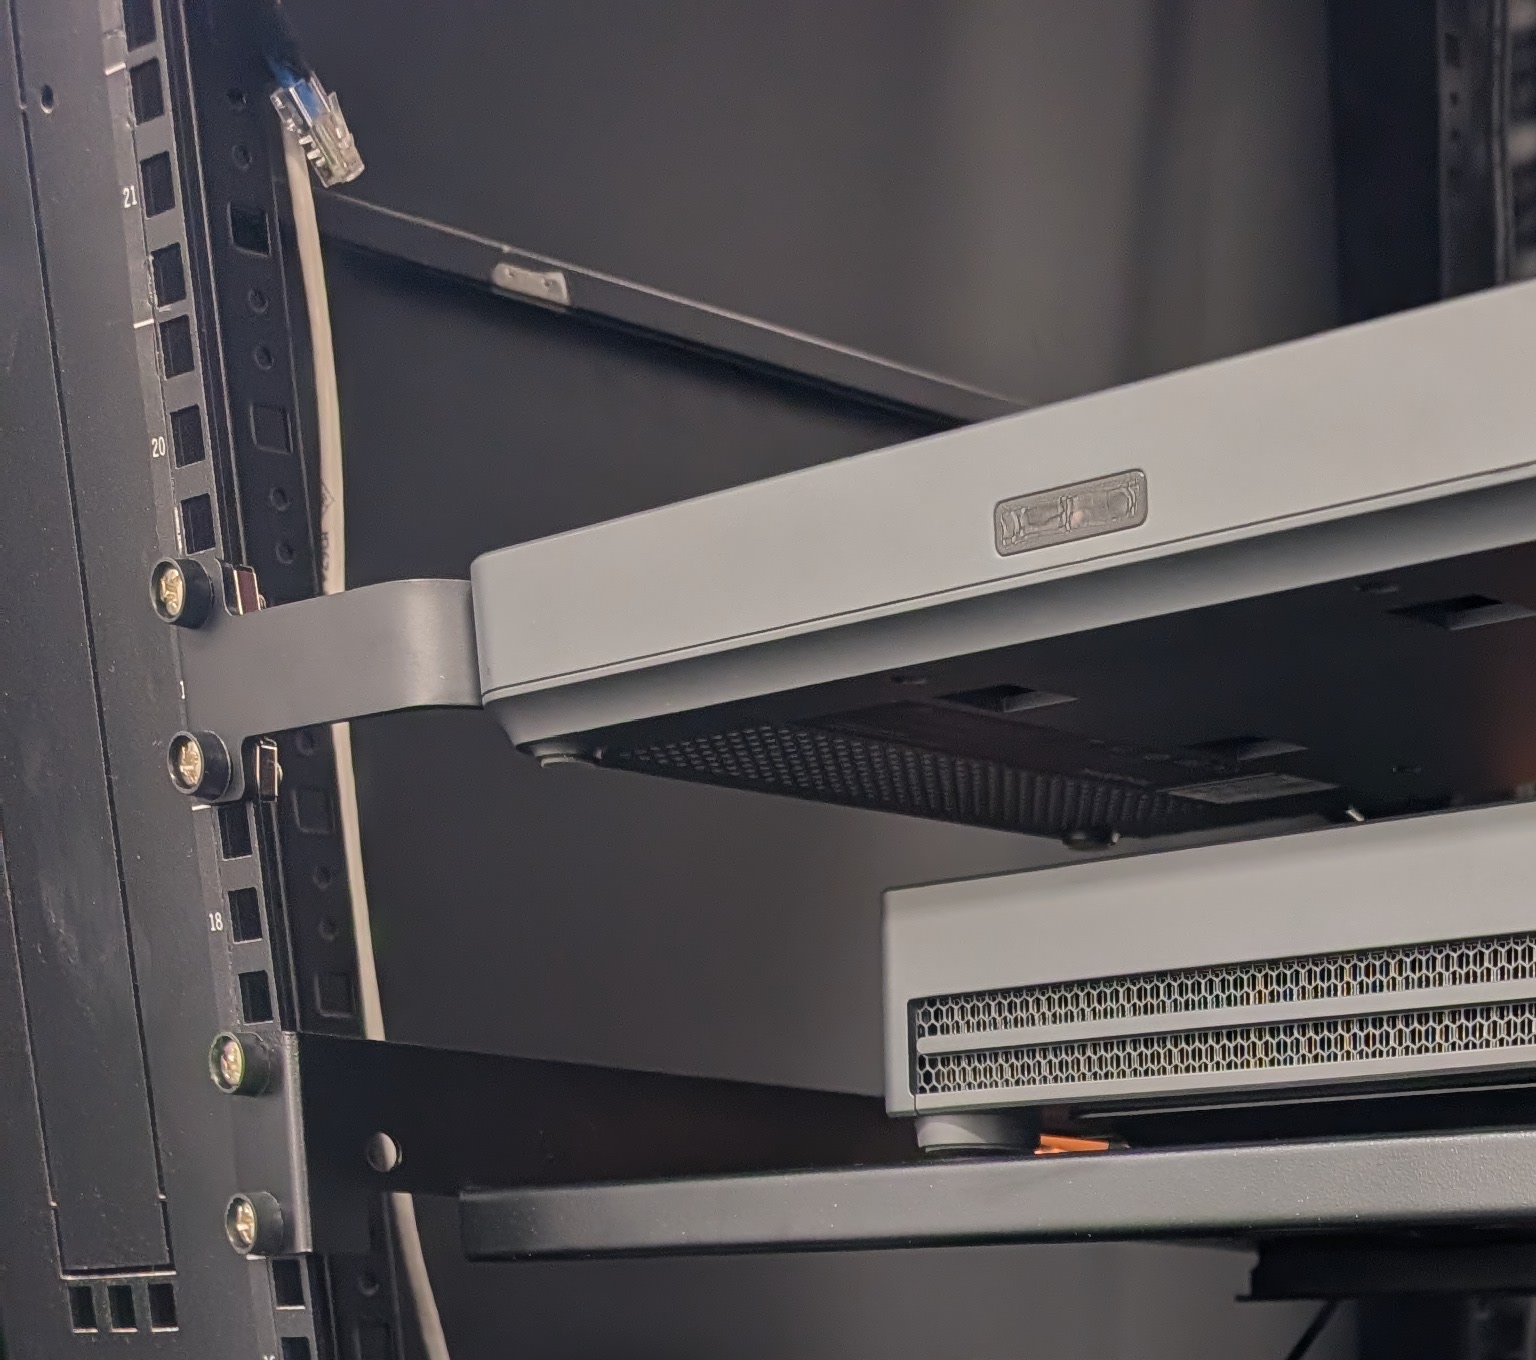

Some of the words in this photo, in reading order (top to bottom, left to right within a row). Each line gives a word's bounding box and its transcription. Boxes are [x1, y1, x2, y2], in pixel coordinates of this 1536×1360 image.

[122, 186, 137, 208] 21
[151, 437, 165, 458] 20
[208, 912, 223, 932] 18
